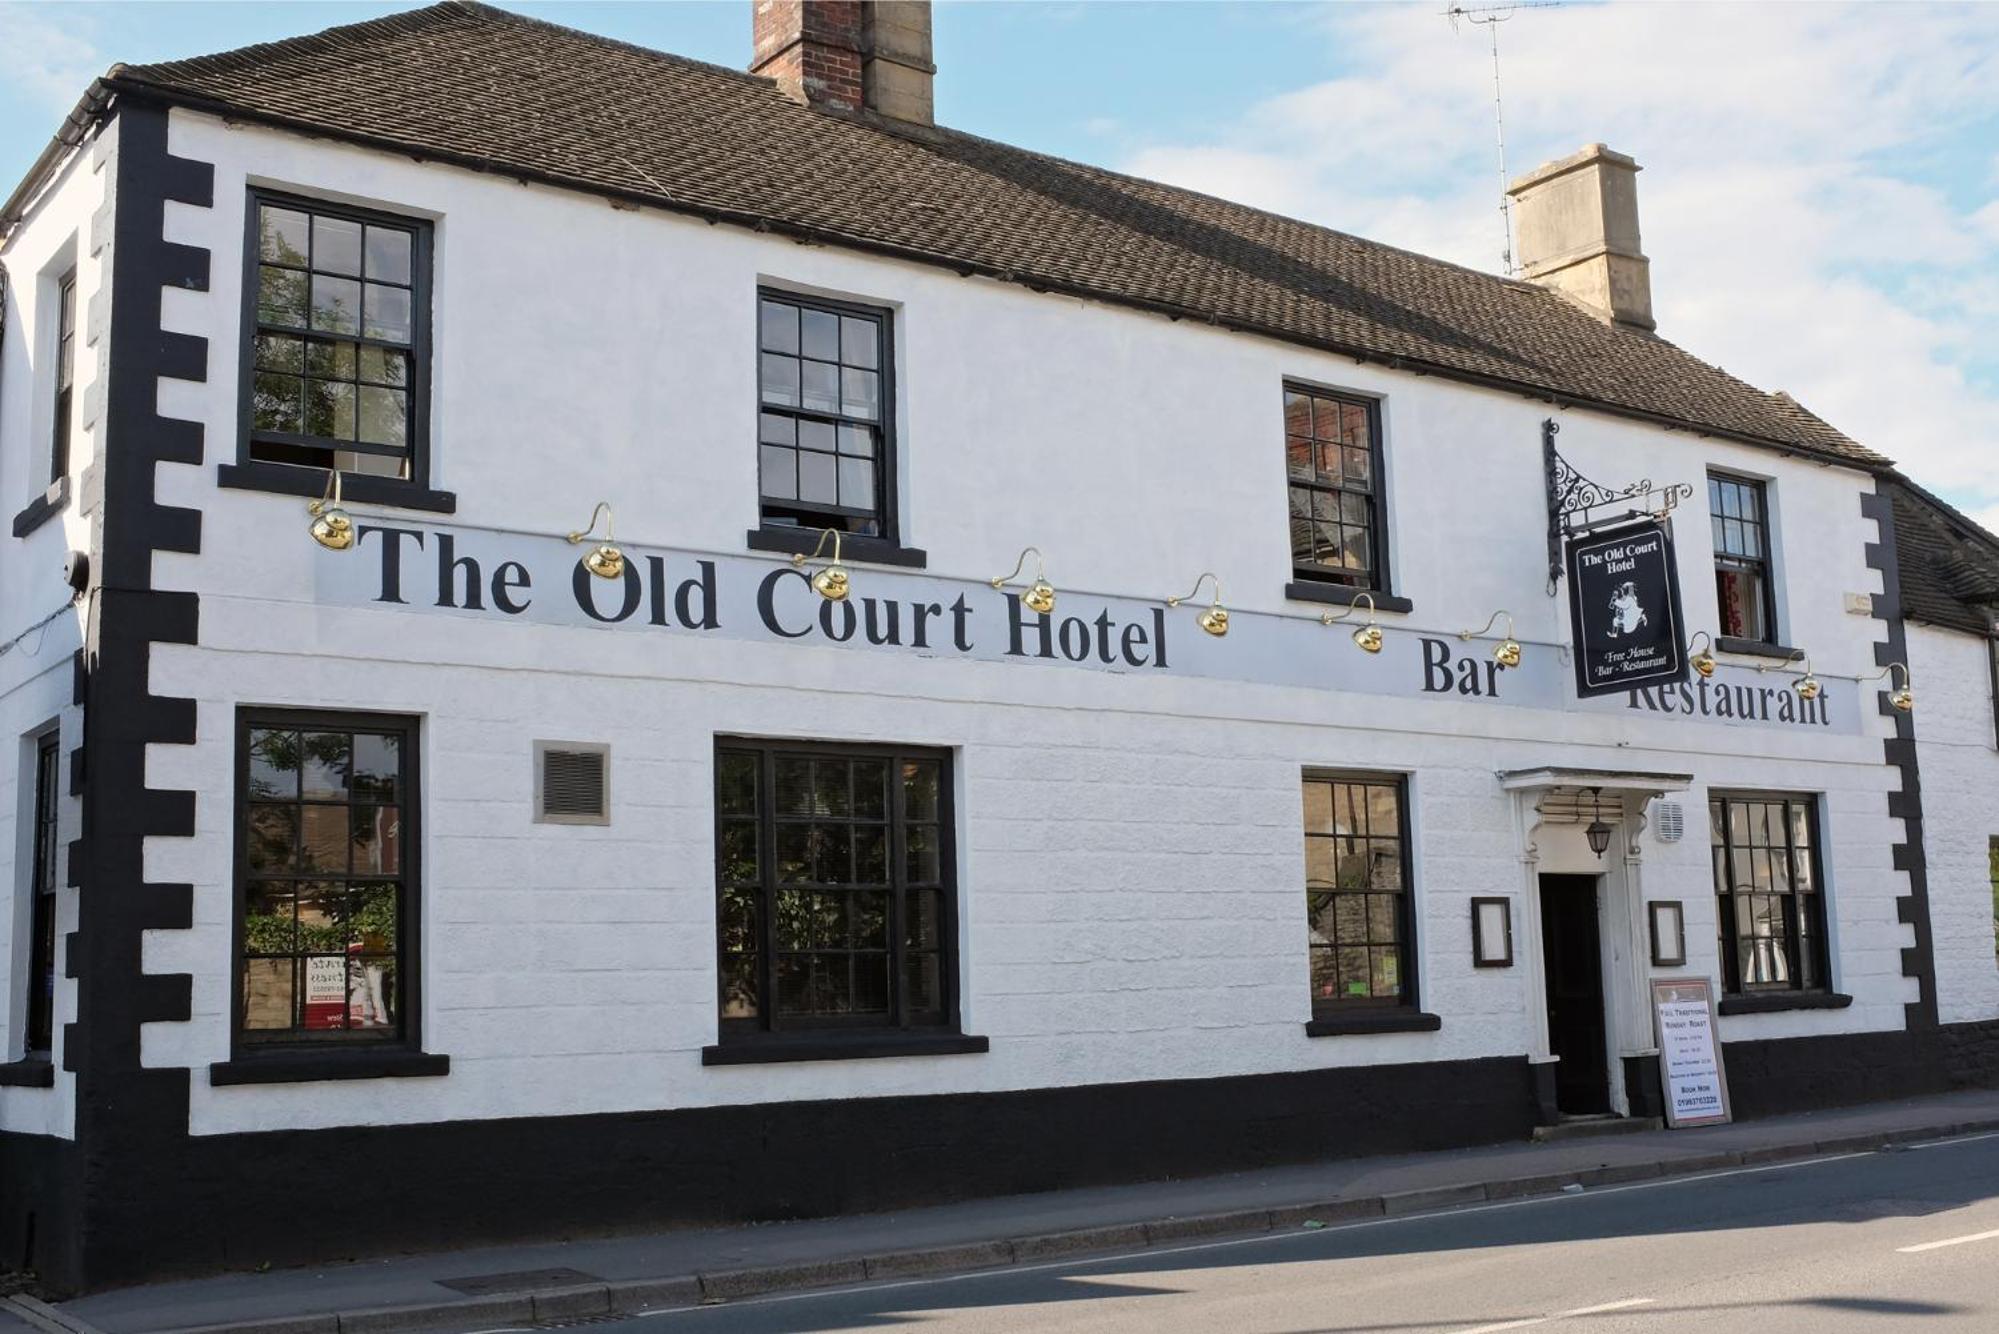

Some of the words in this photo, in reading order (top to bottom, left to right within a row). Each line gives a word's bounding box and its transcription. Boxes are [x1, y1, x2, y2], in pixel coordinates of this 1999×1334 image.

[1583, 553, 1602, 567] The
[1604, 547, 1624, 562] Old
[1626, 540, 1658, 557] Court
[1607, 558, 1635, 574] Hotel
[358, 524, 532, 614] The
[572, 553, 722, 630] Old
[756, 568, 974, 652] Court
[1002, 591, 1170, 668] Hotel
[1595, 664, 1613, 677] Bar
[1620, 655, 1667, 673] Restaurant
[1604, 650, 1625, 663] Free
[1627, 645, 1655, 660] House
[1418, 637, 1506, 697] Bar
